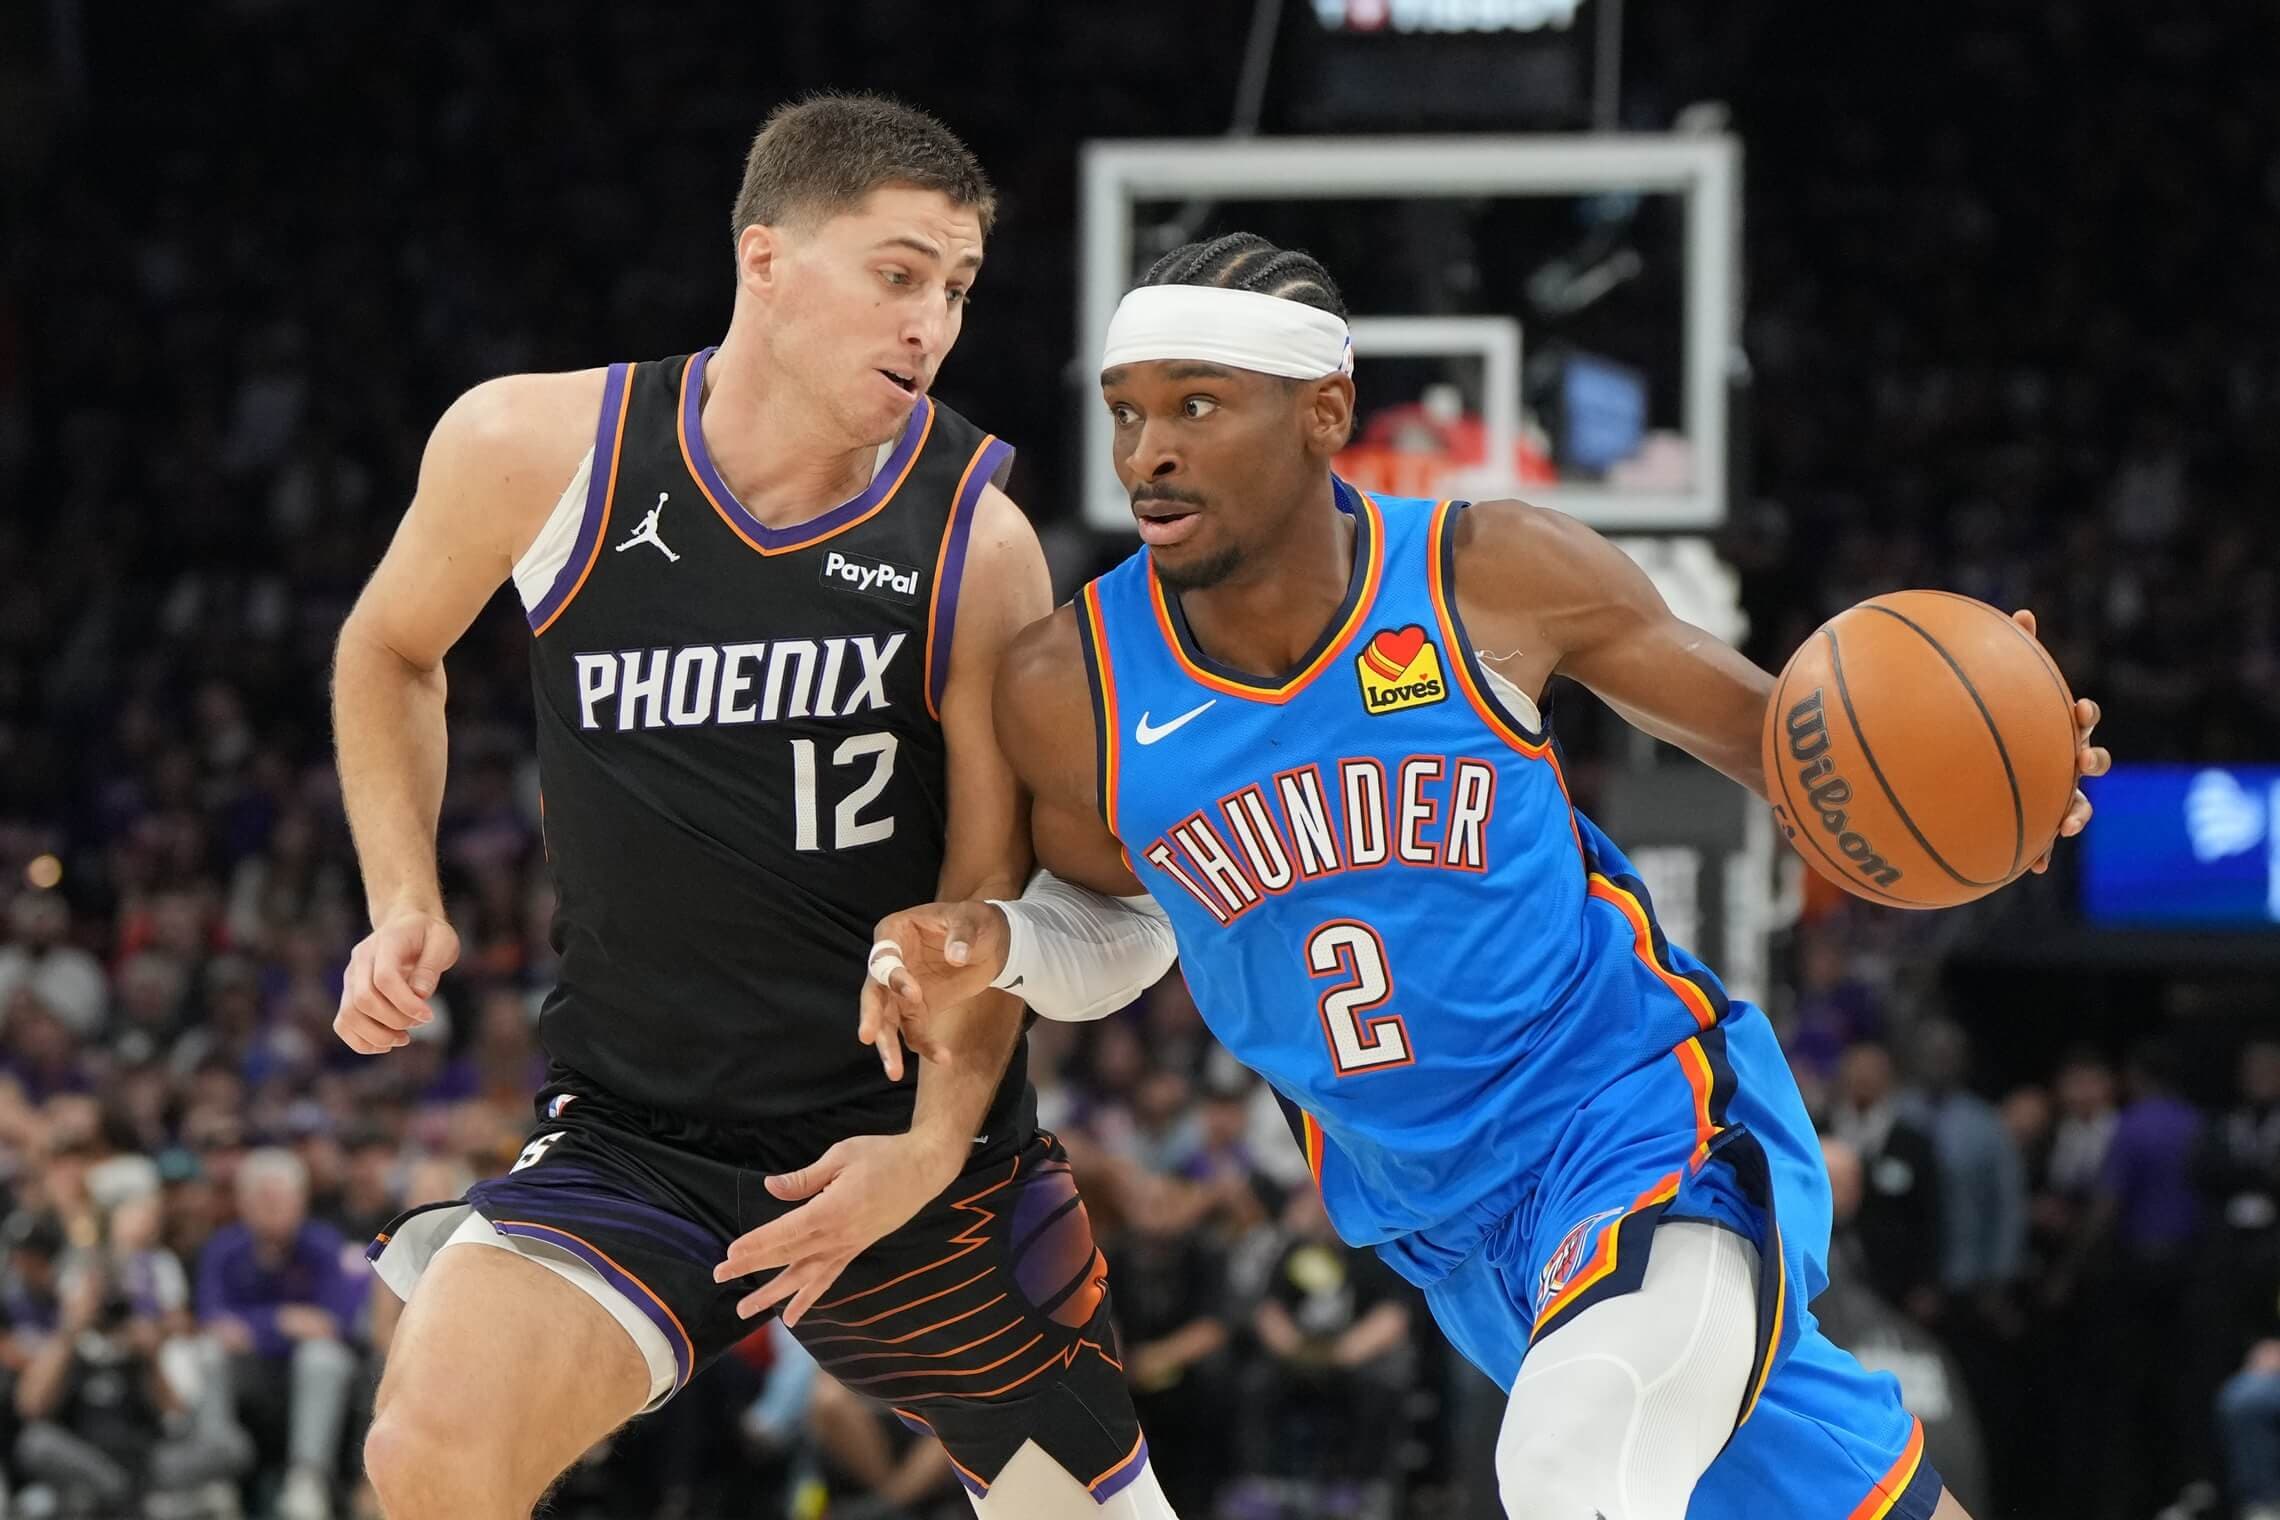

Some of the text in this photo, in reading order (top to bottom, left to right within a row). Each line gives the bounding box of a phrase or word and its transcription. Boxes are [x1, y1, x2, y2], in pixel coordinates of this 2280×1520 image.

[825, 552, 919, 595] PayPal
[574, 631, 908, 732] PHOENIX
[790, 731, 899, 852] 12
[1142, 754, 1496, 927] THUNDER
[1786, 687, 1903, 888] Wilson
[1304, 918, 1415, 1077] 2
